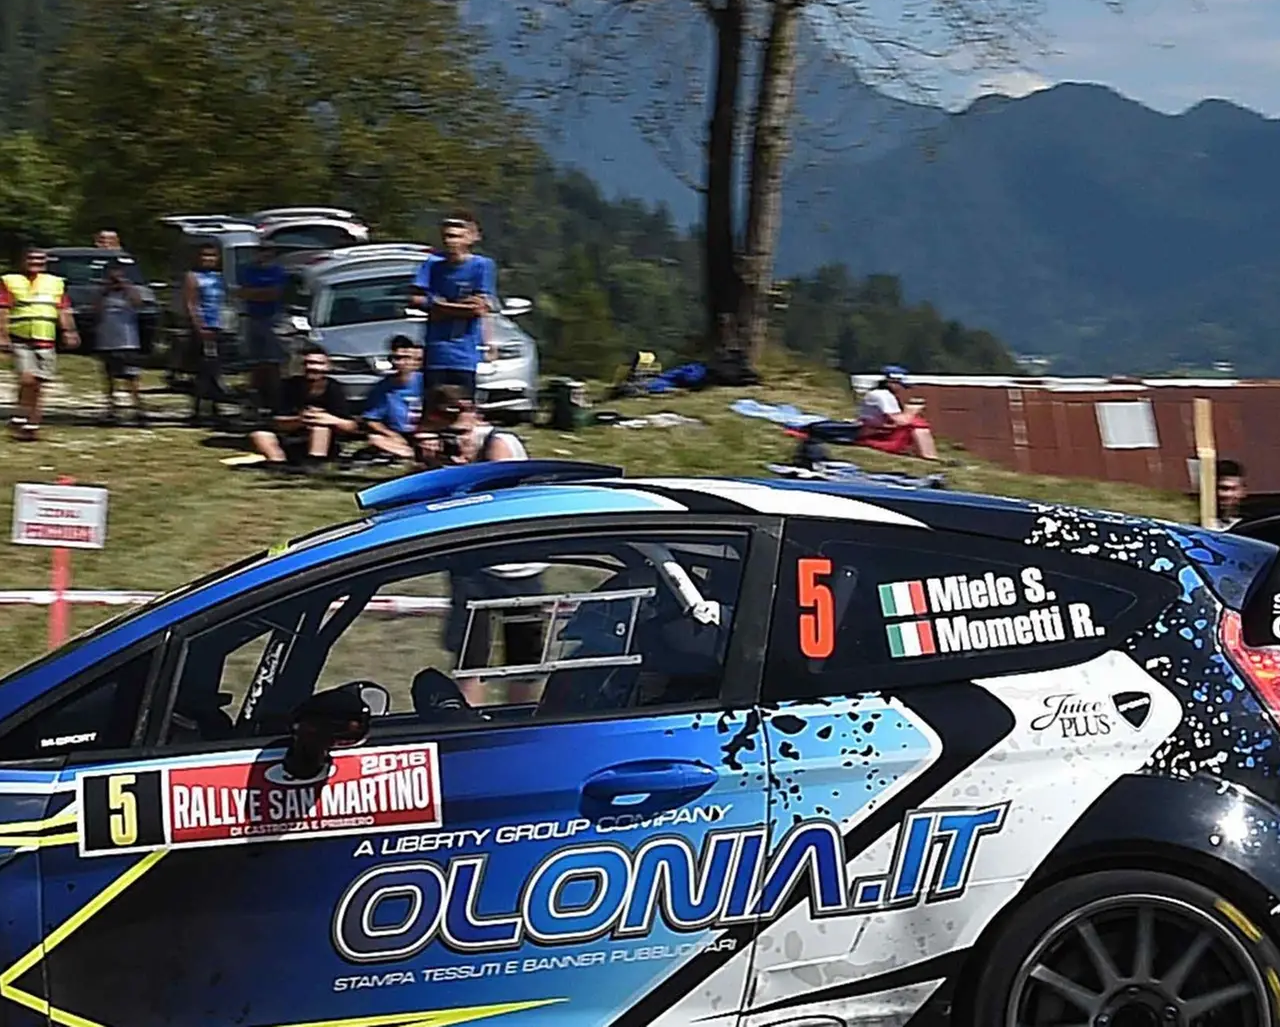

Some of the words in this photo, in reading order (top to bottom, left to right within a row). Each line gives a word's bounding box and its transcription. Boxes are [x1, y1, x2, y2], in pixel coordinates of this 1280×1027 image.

[798, 558, 835, 658] 5
[926, 572, 1017, 613] Miele
[1021, 566, 1056, 602] S.
[934, 605, 1065, 653] Mometti
[1069, 602, 1106, 639] R.
[1030, 692, 1104, 731] Juice
[1059, 714, 1111, 738] PLUS
[360, 751, 427, 774] 2016
[108, 775, 137, 846] 5
[171, 785, 261, 830] RALLYE
[269, 785, 318, 821] SAN
[320, 766, 430, 818] MARTINO
[353, 841, 374, 857] A
[381, 829, 489, 855] LIBERTY
[495, 819, 591, 845] GROUP
[595, 803, 734, 834] COMPANY
[332, 801, 1012, 964] OLONIA.IT
[333, 973, 416, 992] STAMPA
[424, 963, 501, 983] TESSUTI
[505, 962, 519, 974] E
[522, 951, 606, 973] BANNER
